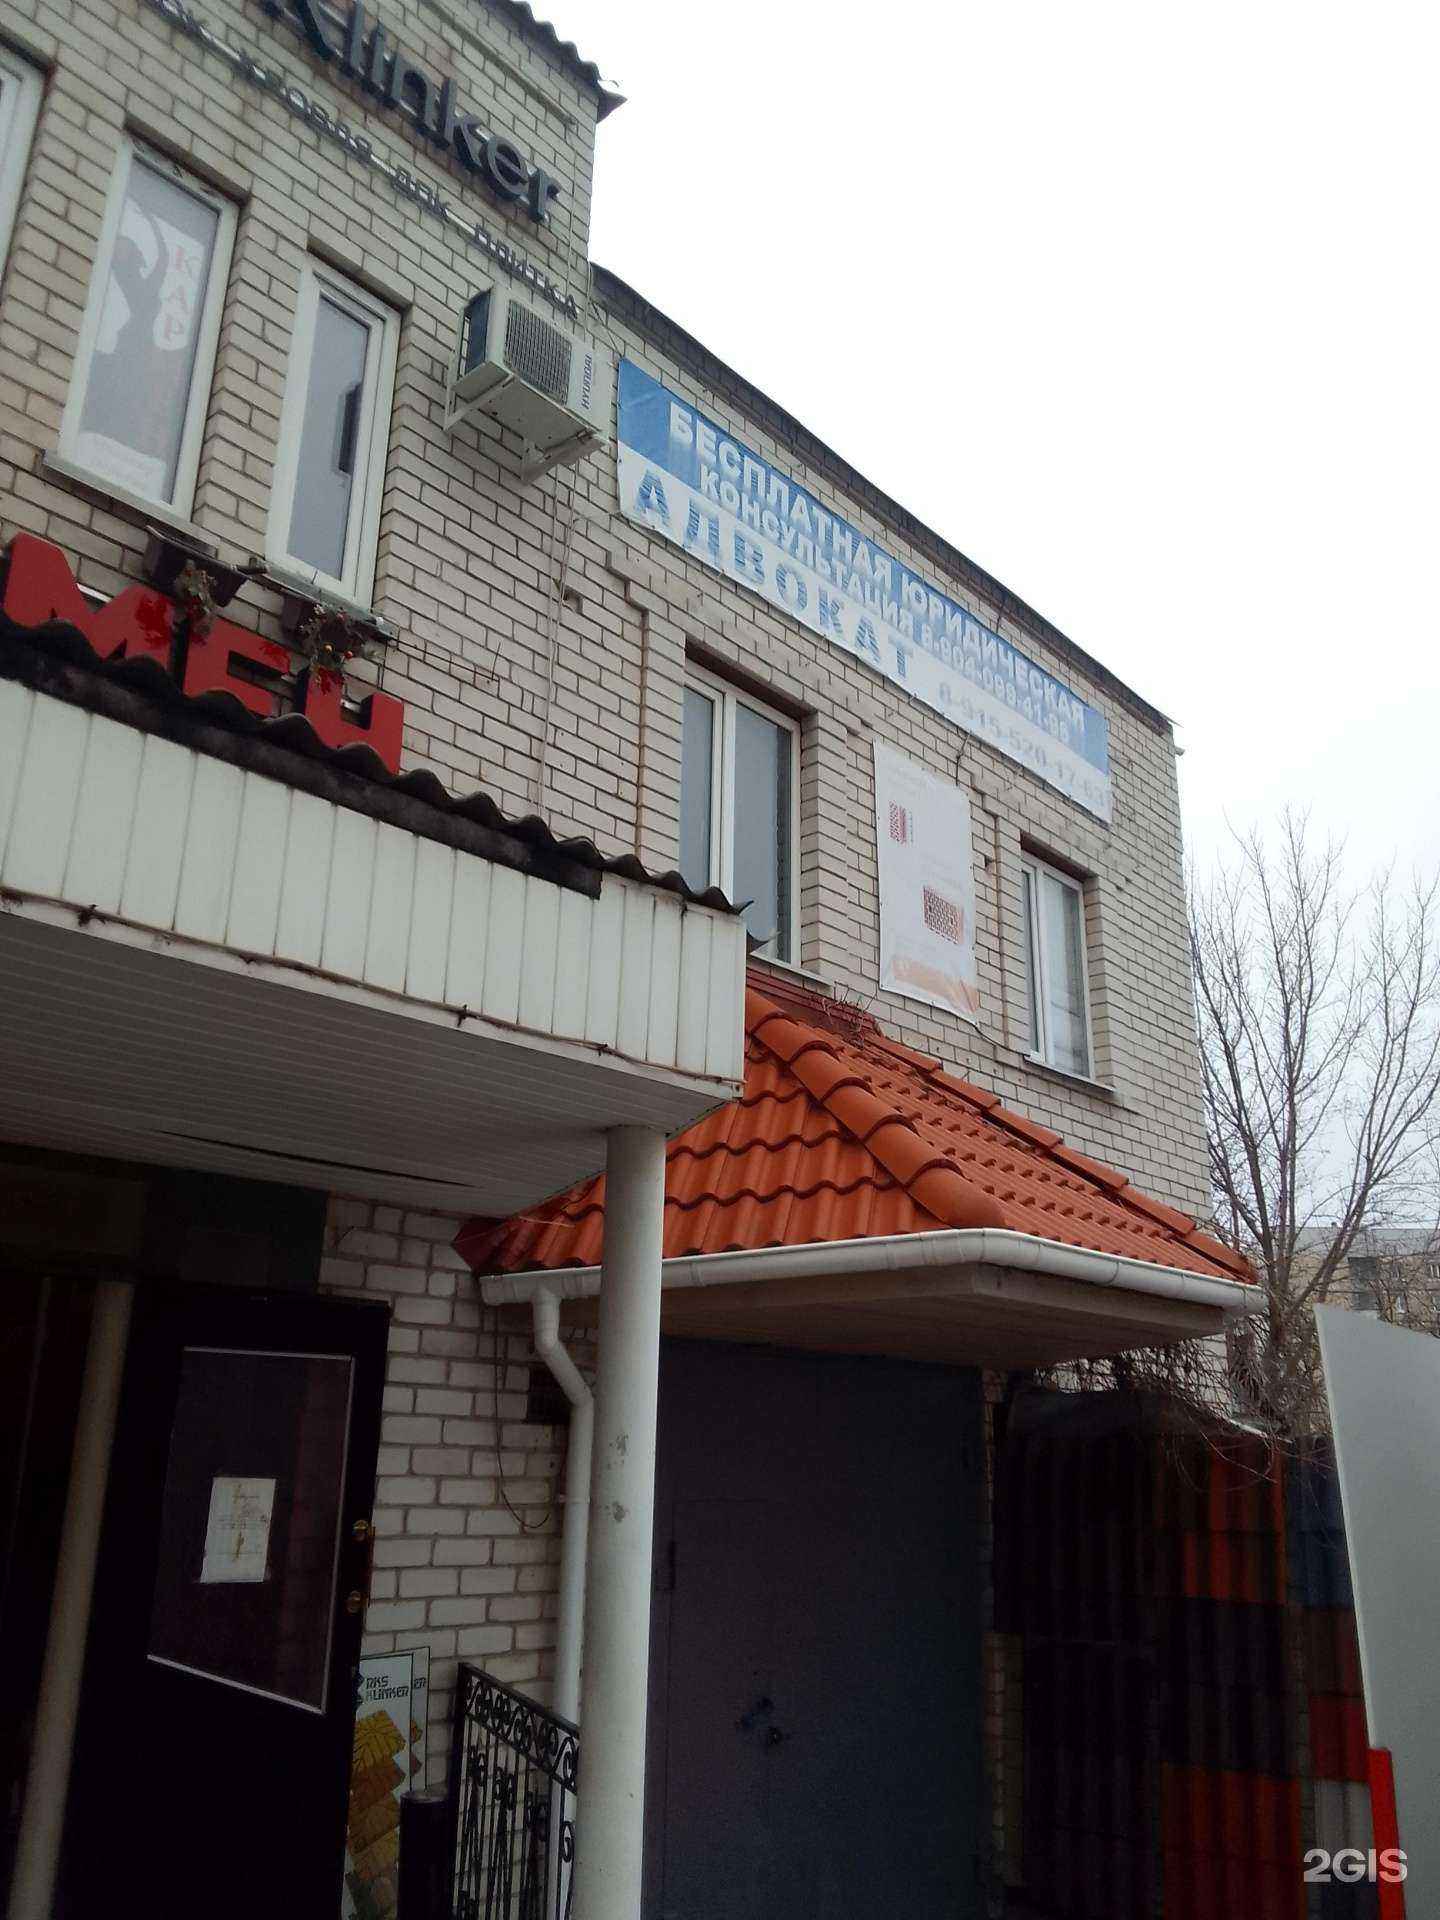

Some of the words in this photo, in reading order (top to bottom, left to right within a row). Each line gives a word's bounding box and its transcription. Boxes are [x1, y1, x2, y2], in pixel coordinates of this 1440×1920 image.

[472, 222, 580, 320] ПЛИТКА
[581, 353, 593, 410] HYUNDAI
[635, 469, 914, 678] АДВОКАТ
[669, 401, 893, 592] БЕСПЛАТНАЯ
[901, 572, 1086, 734] ЮРИДИЧЕСКАЯ
[700, 463, 915, 642] КОНСУЛЬТАЦИЯ
